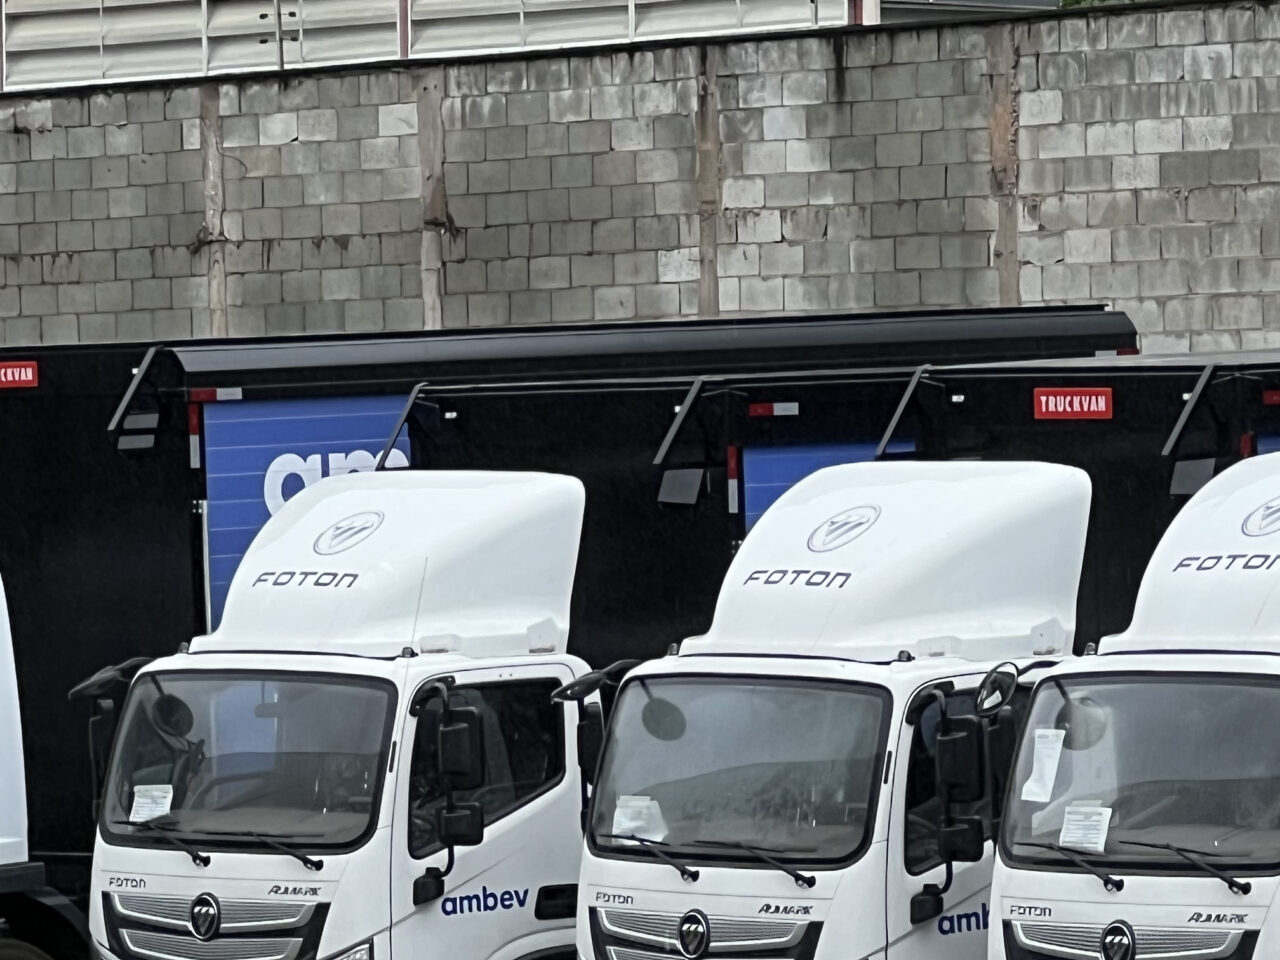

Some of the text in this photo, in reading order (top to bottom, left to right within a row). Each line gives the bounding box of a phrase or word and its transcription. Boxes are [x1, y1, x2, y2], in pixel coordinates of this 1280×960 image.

[1040, 395, 1106, 412] TRUCKVAN
[252, 571, 359, 588] FOTON
[743, 569, 852, 588] FOTON
[109, 877, 146, 888] FOTON
[441, 886, 529, 916] ambev
[595, 892, 634, 904] FOTON
[1010, 905, 1052, 916] FOTON
